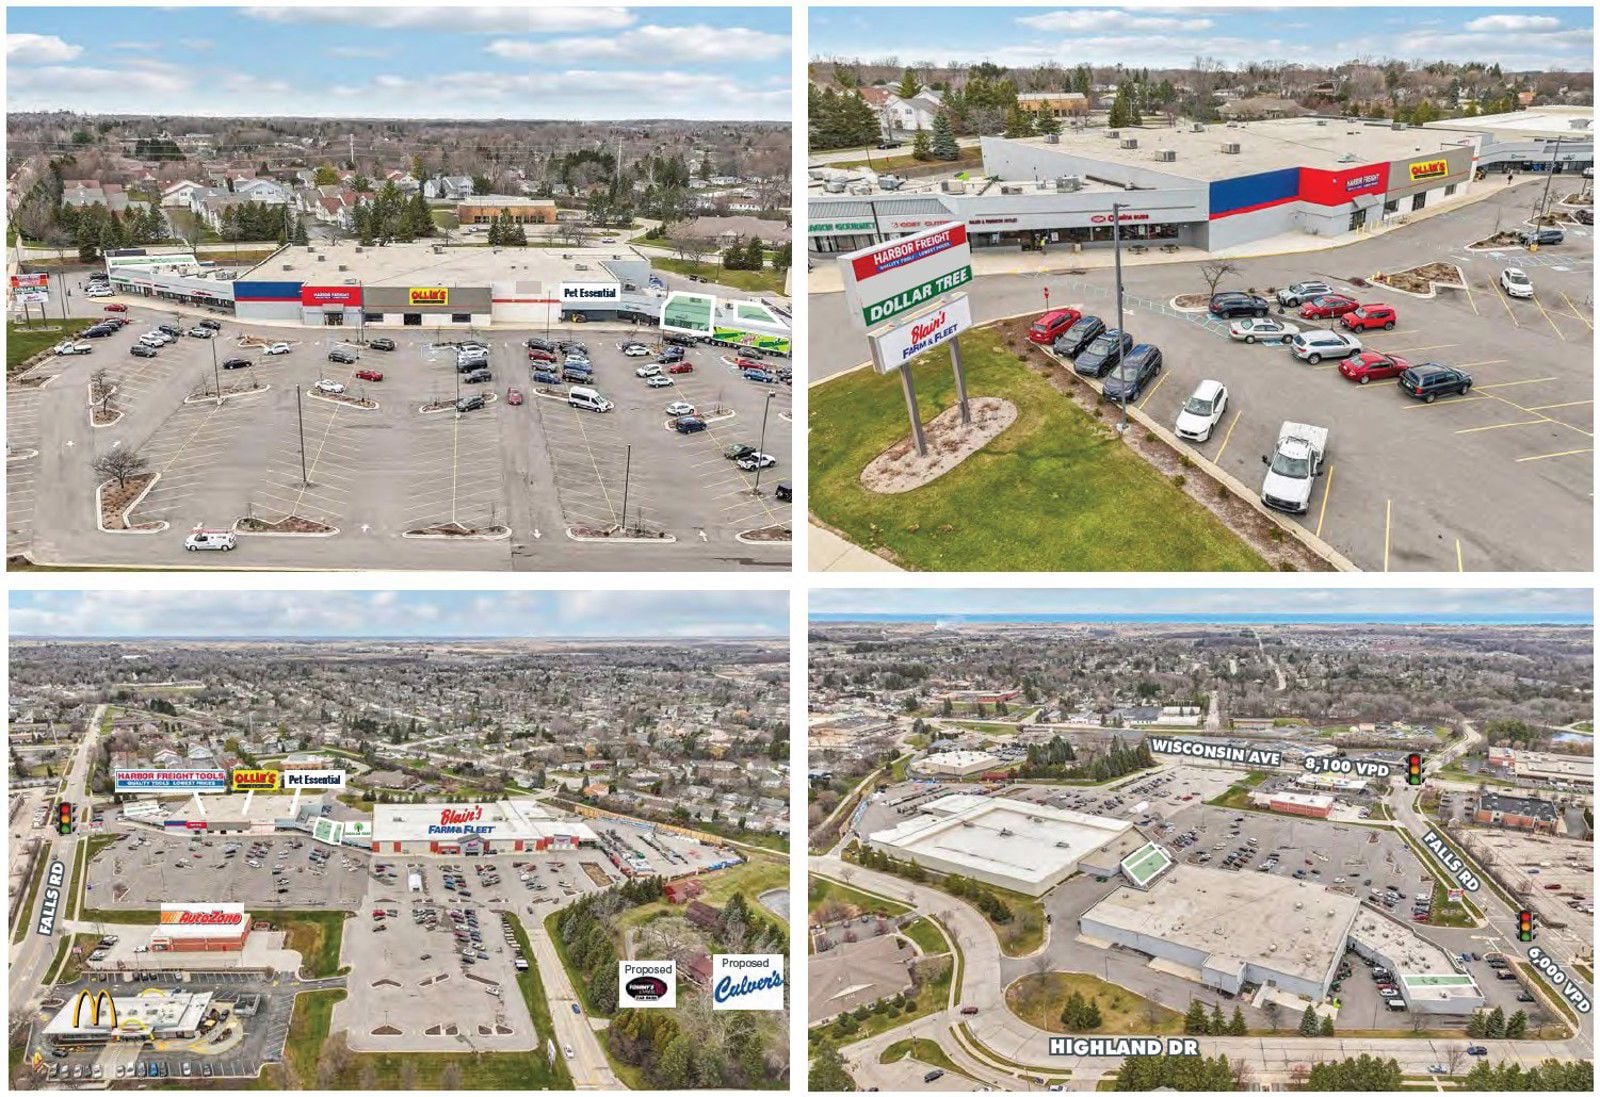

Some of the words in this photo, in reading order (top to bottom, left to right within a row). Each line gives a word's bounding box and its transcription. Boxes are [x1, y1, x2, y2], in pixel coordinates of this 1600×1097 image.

[873, 240, 914, 265] HARBOR
[915, 230, 951, 249] FREIGHT
[870, 284, 932, 321] DOLLAR
[935, 268, 969, 292] TREE
[902, 341, 927, 359] FARM
[928, 337, 933, 346] &
[934, 324, 958, 343] FLEET
[911, 310, 946, 345] Blain's
